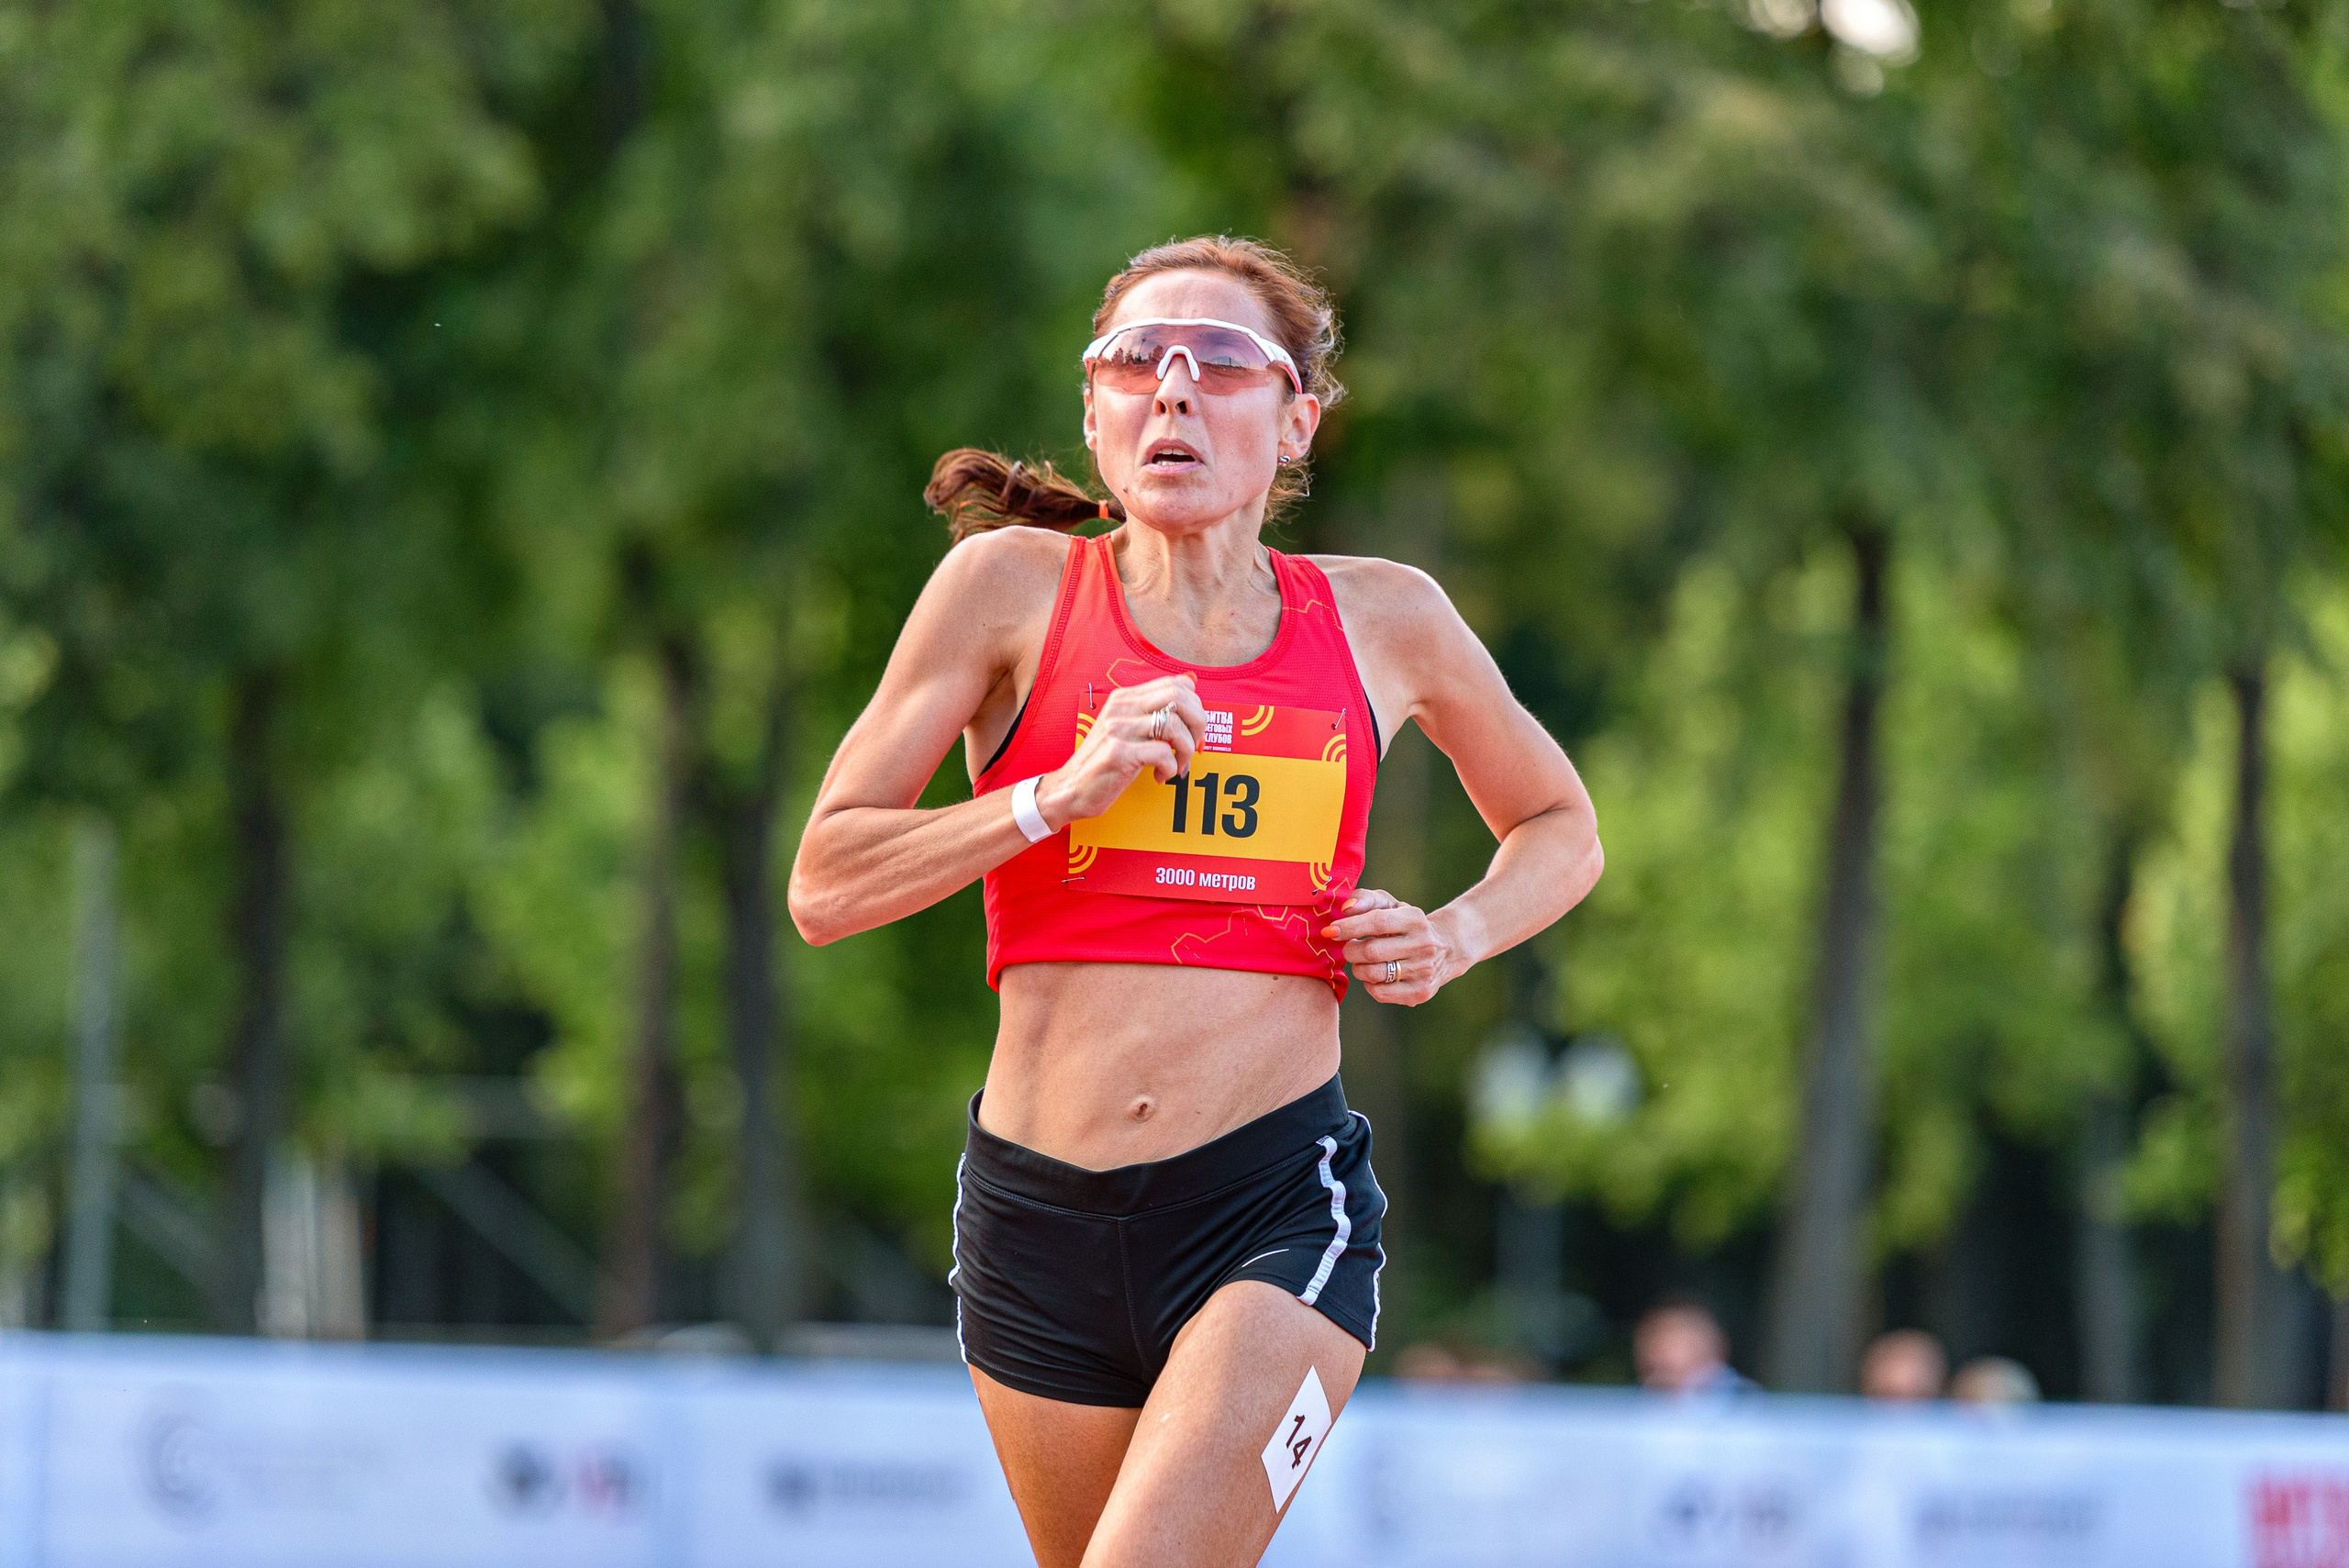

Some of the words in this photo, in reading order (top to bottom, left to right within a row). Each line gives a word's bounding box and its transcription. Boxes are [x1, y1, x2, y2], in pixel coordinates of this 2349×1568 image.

[1165, 771, 1260, 839] 113
[1155, 867, 1196, 886] 3000
[1198, 873, 1256, 892] метров
[1286, 1414, 1312, 1470] 14
